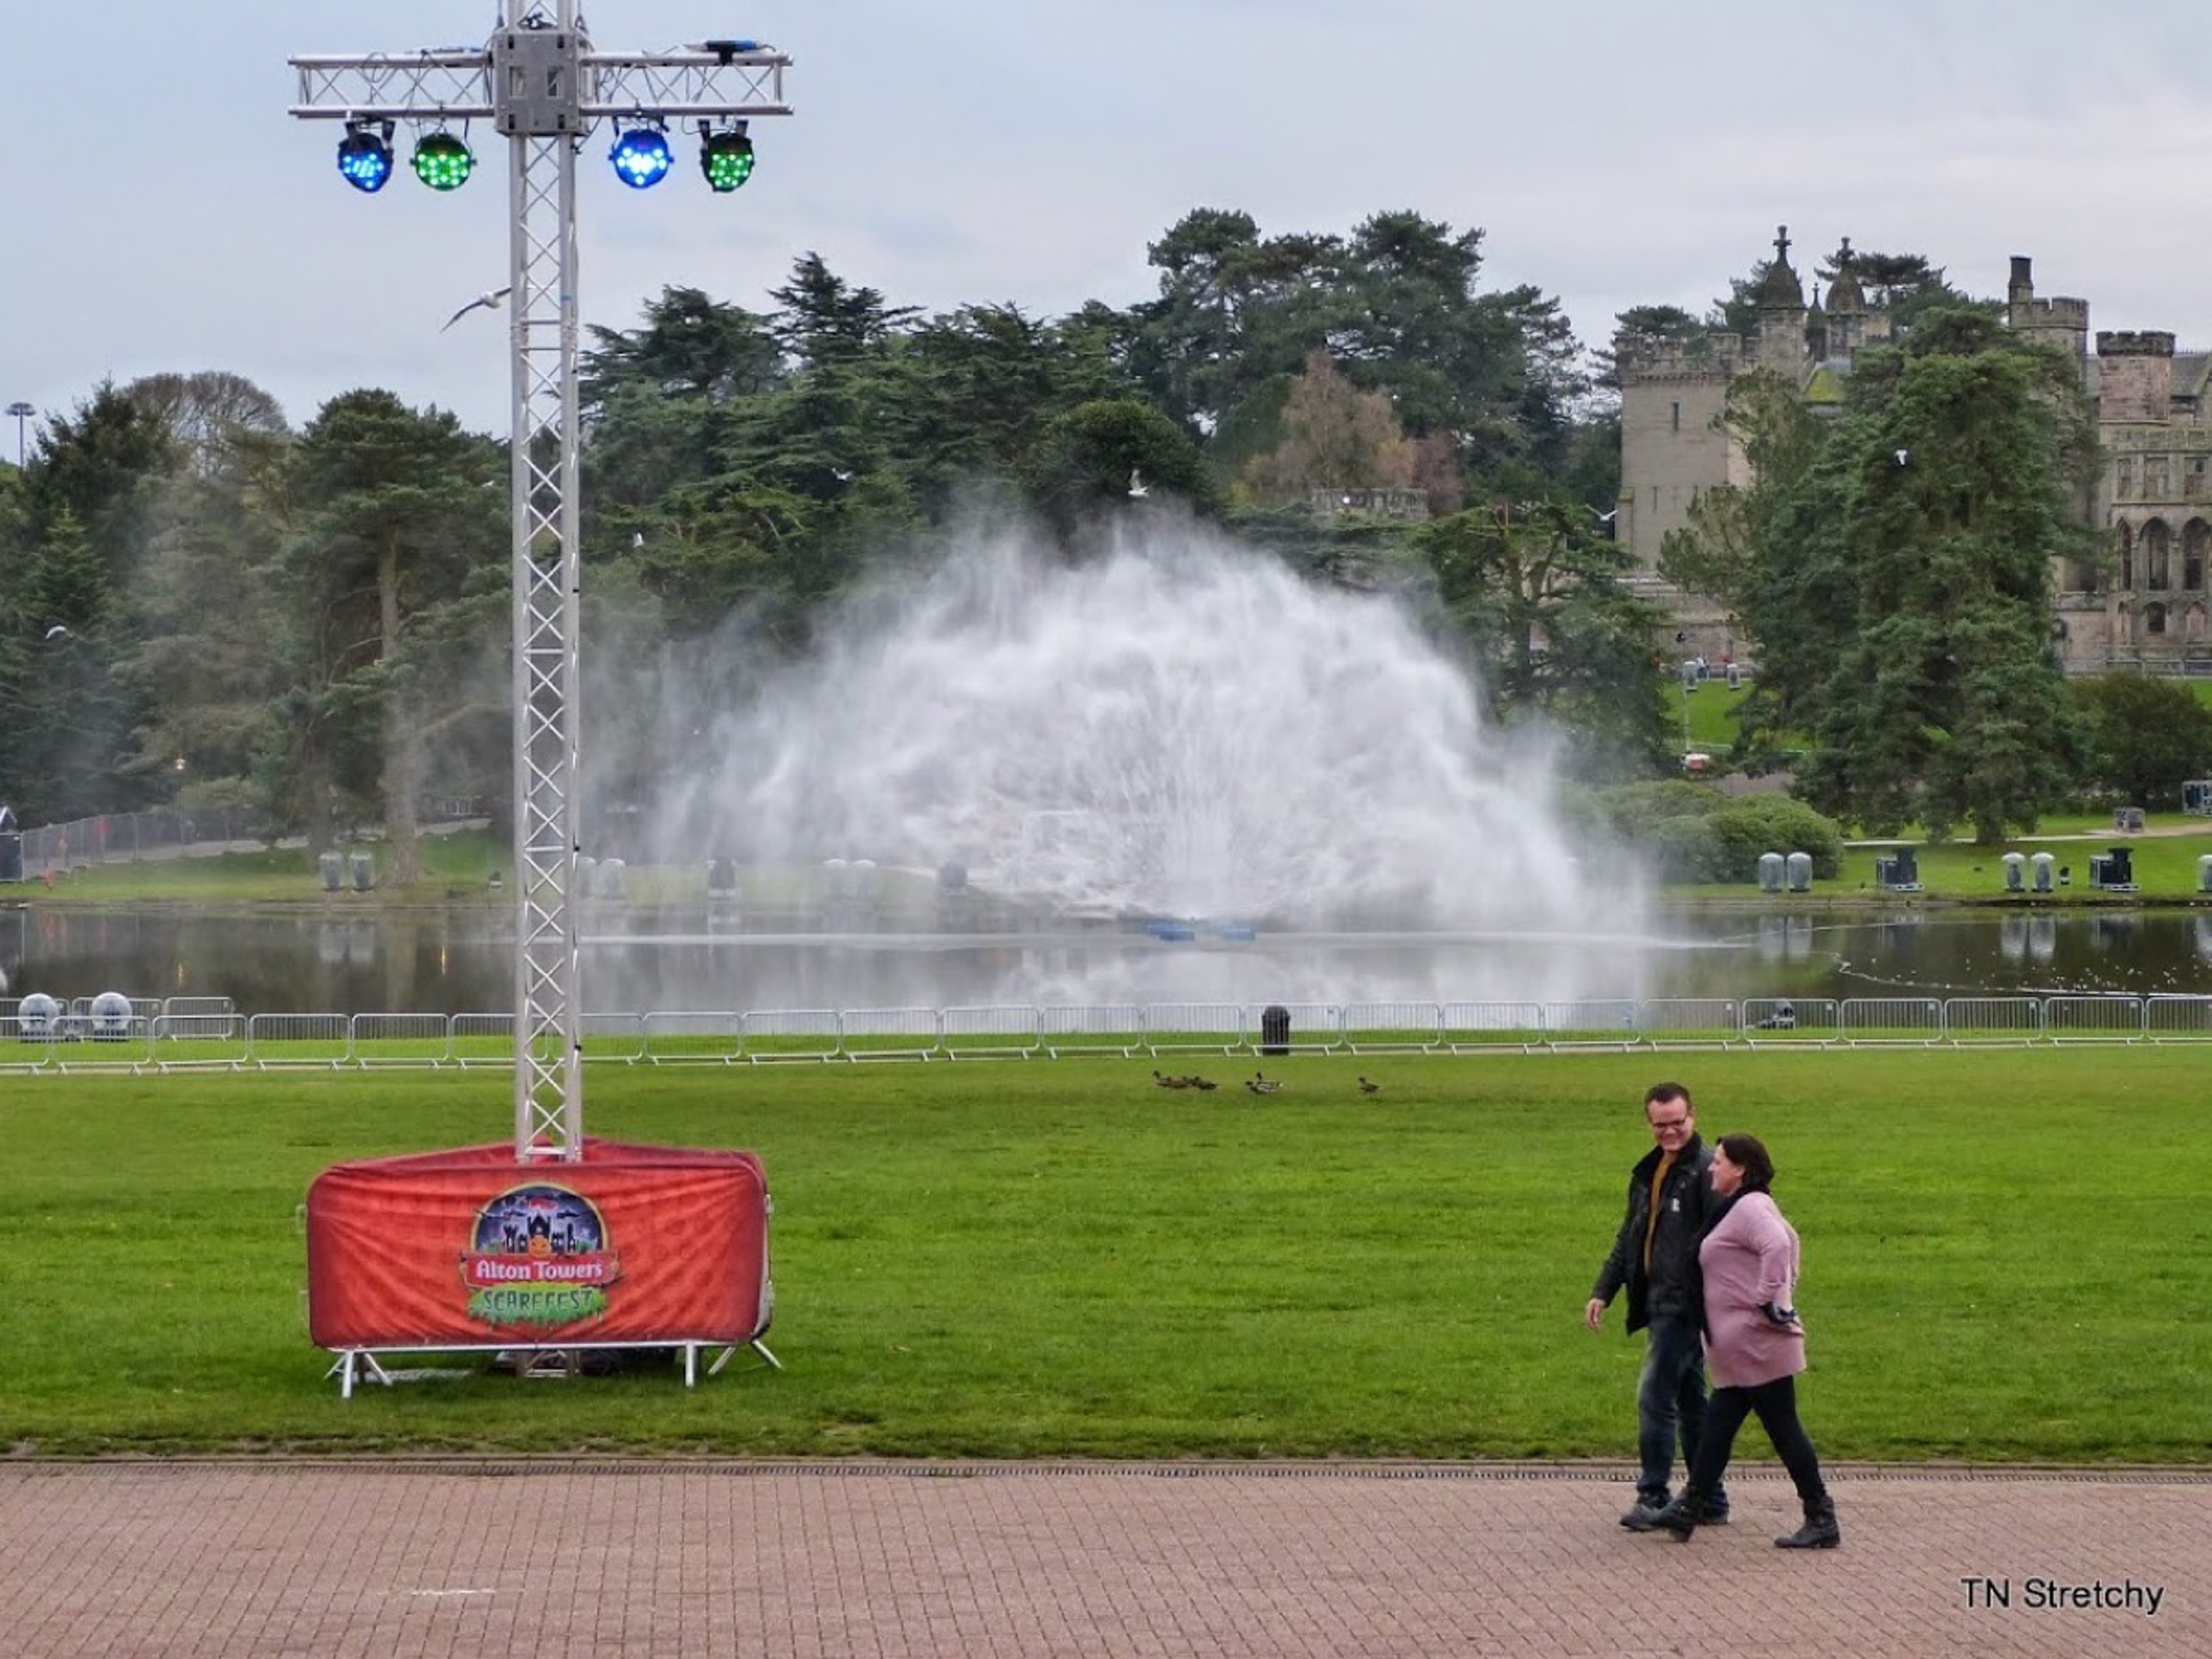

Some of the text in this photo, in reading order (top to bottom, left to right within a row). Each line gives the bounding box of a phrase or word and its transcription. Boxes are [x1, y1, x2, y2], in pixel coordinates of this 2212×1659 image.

[476, 1259, 602, 1280] Alton Towers
[482, 1290, 593, 1312] SCAREFEST
